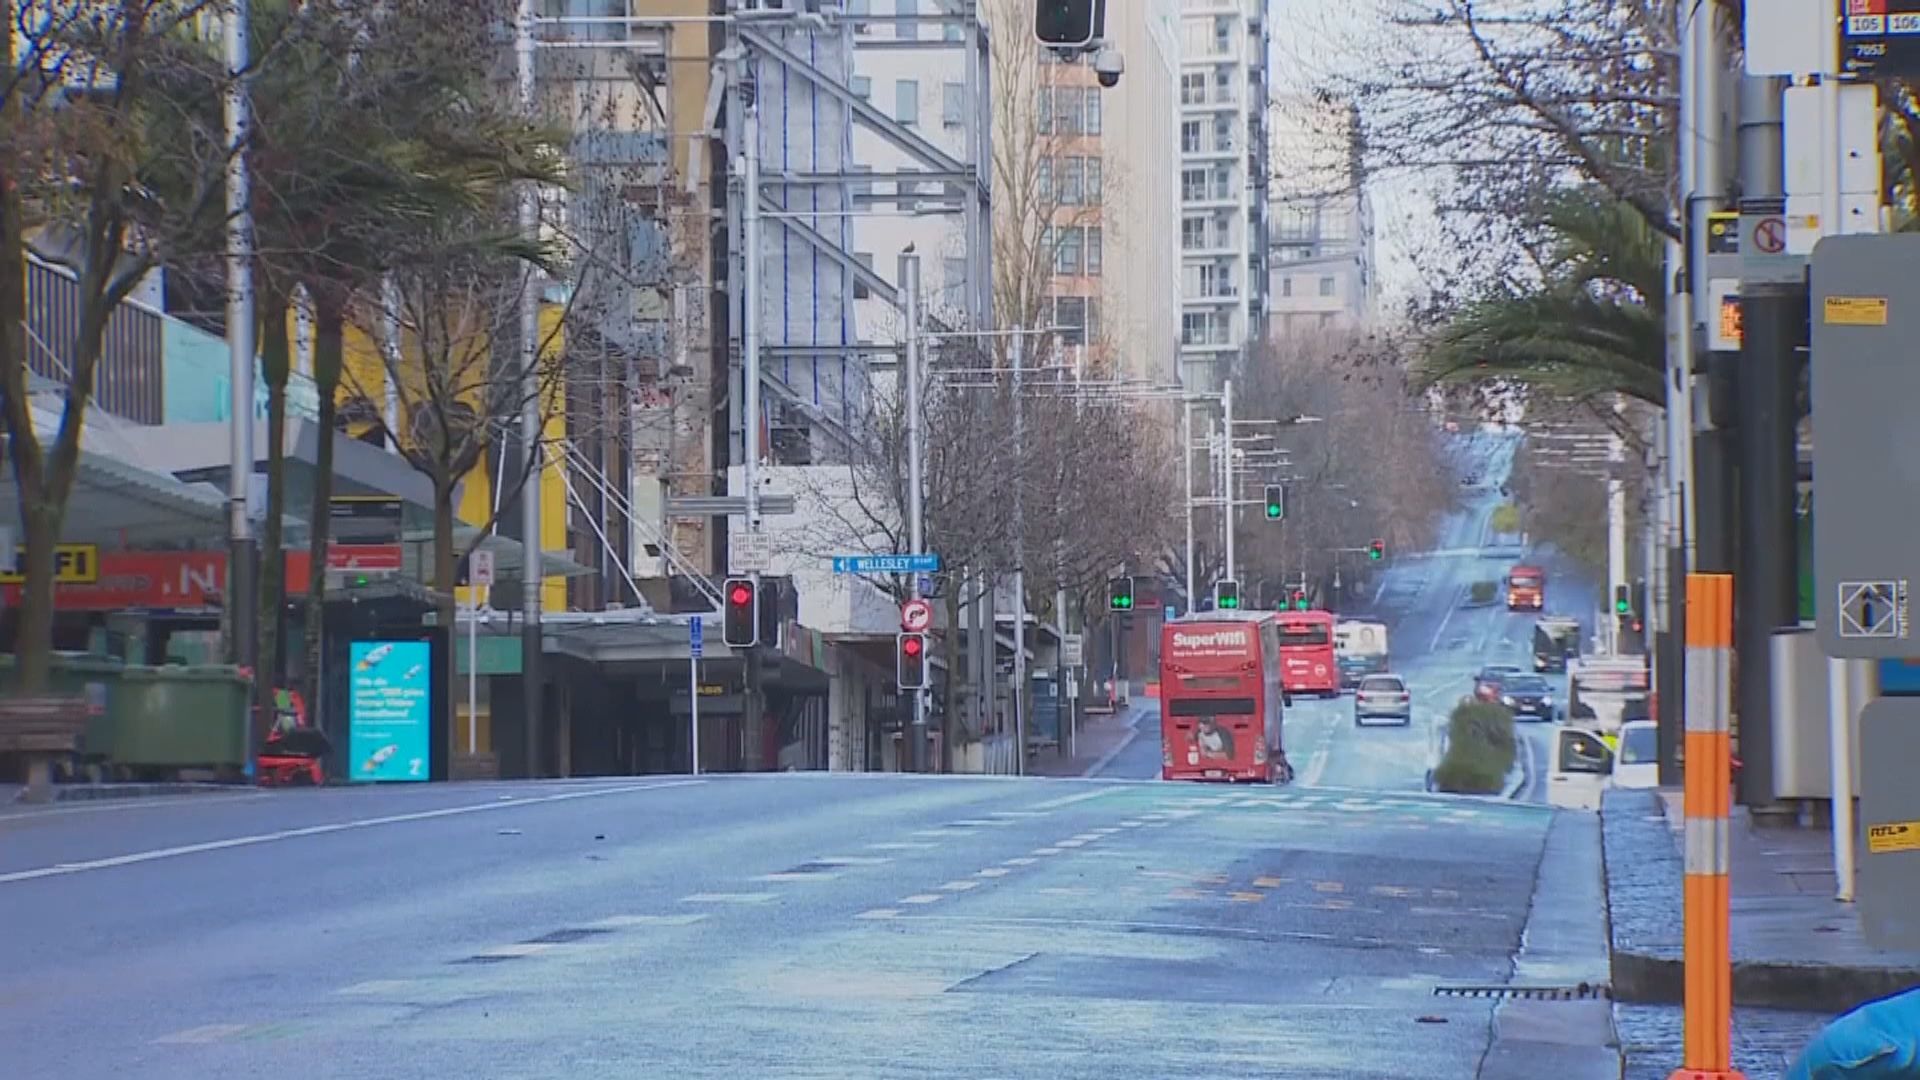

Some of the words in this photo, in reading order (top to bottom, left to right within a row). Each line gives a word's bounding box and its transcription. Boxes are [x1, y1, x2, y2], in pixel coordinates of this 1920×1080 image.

[1853, 17, 1878, 31] 105
[1893, 16, 1919, 29] 106
[858, 558, 910, 569] WELLESLEY
